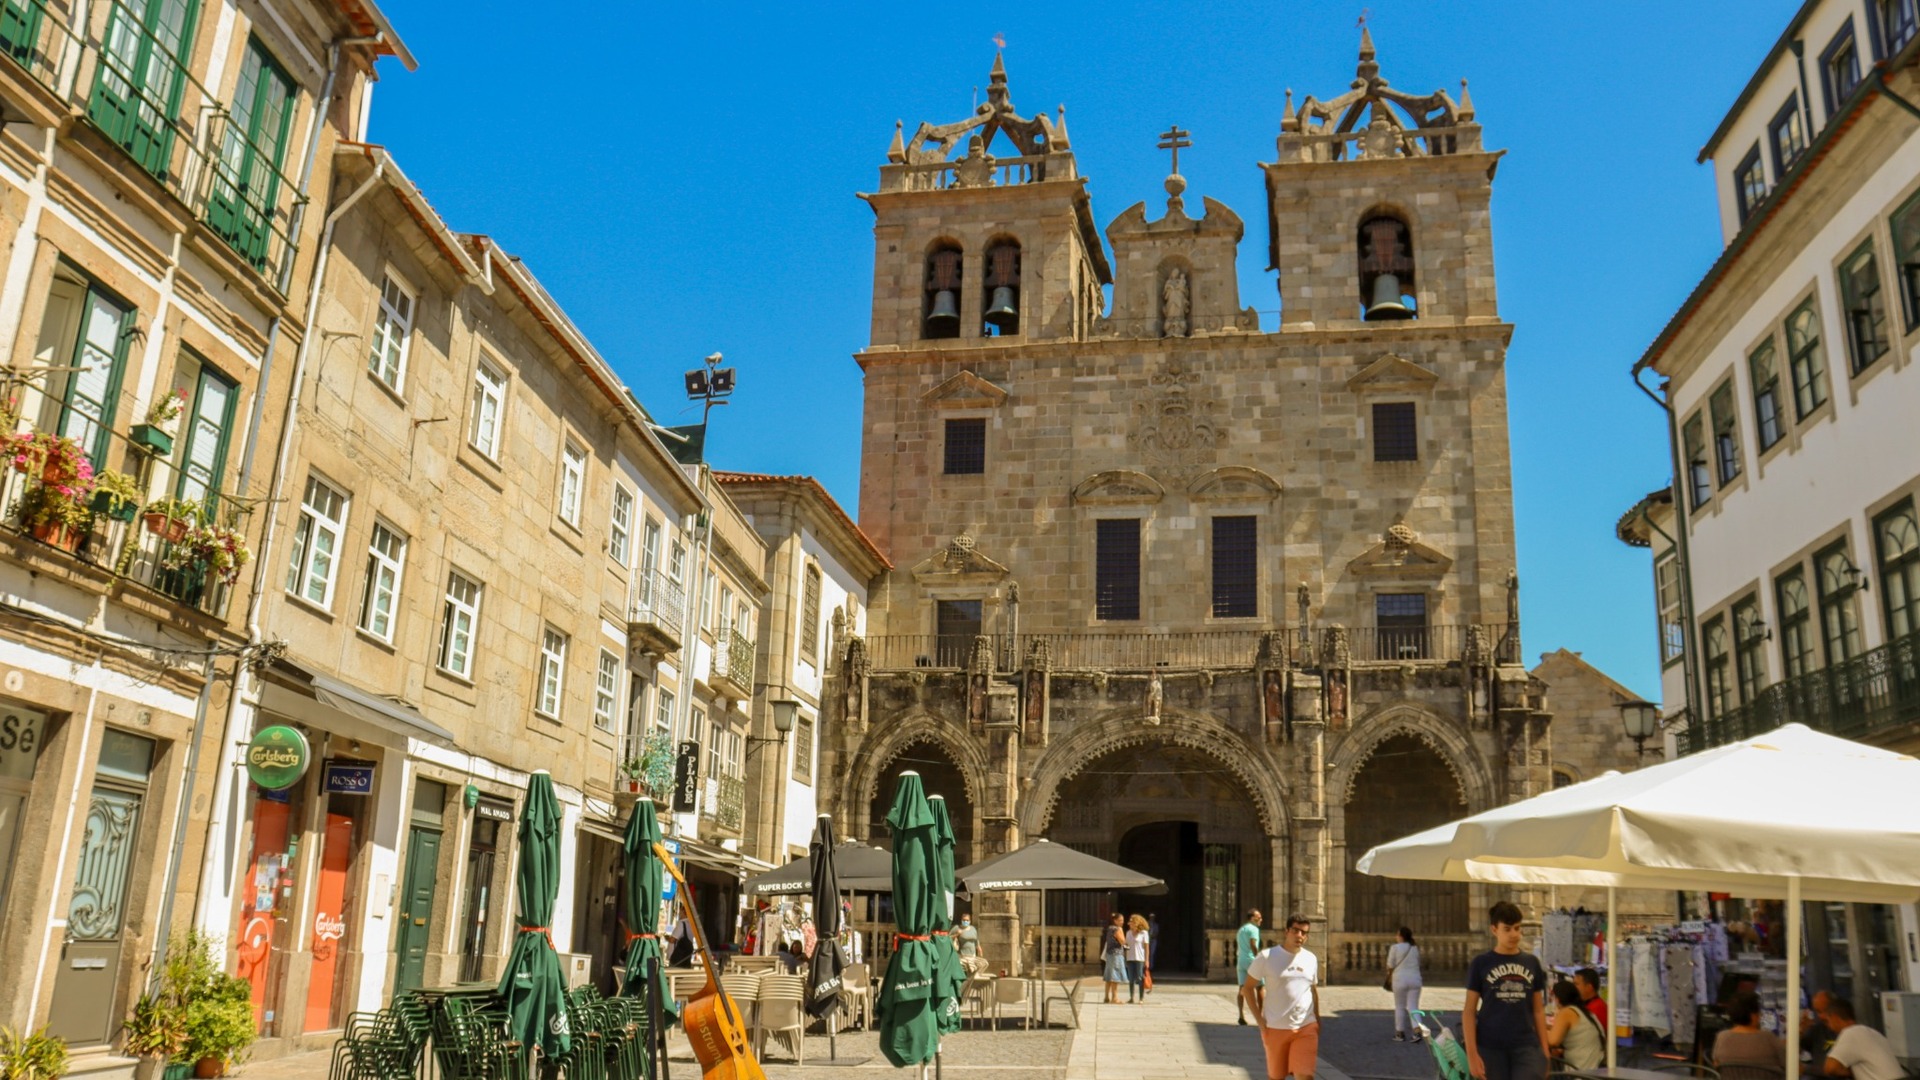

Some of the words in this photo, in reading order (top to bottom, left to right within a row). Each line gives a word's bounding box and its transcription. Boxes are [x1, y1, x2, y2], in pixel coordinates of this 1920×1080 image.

[1, 714, 35, 753] Sé
[250, 746, 299, 769] Carlsberg
[681, 744, 690, 755] P
[684, 756, 696, 804] PLACE
[758, 883, 781, 892] SUPER
[781, 881, 803, 890] BOCK
[979, 881, 1003, 890] SUPER
[315, 912, 345, 941] Carlsberg
[1486, 963, 1534, 984] KNOXVILLE
